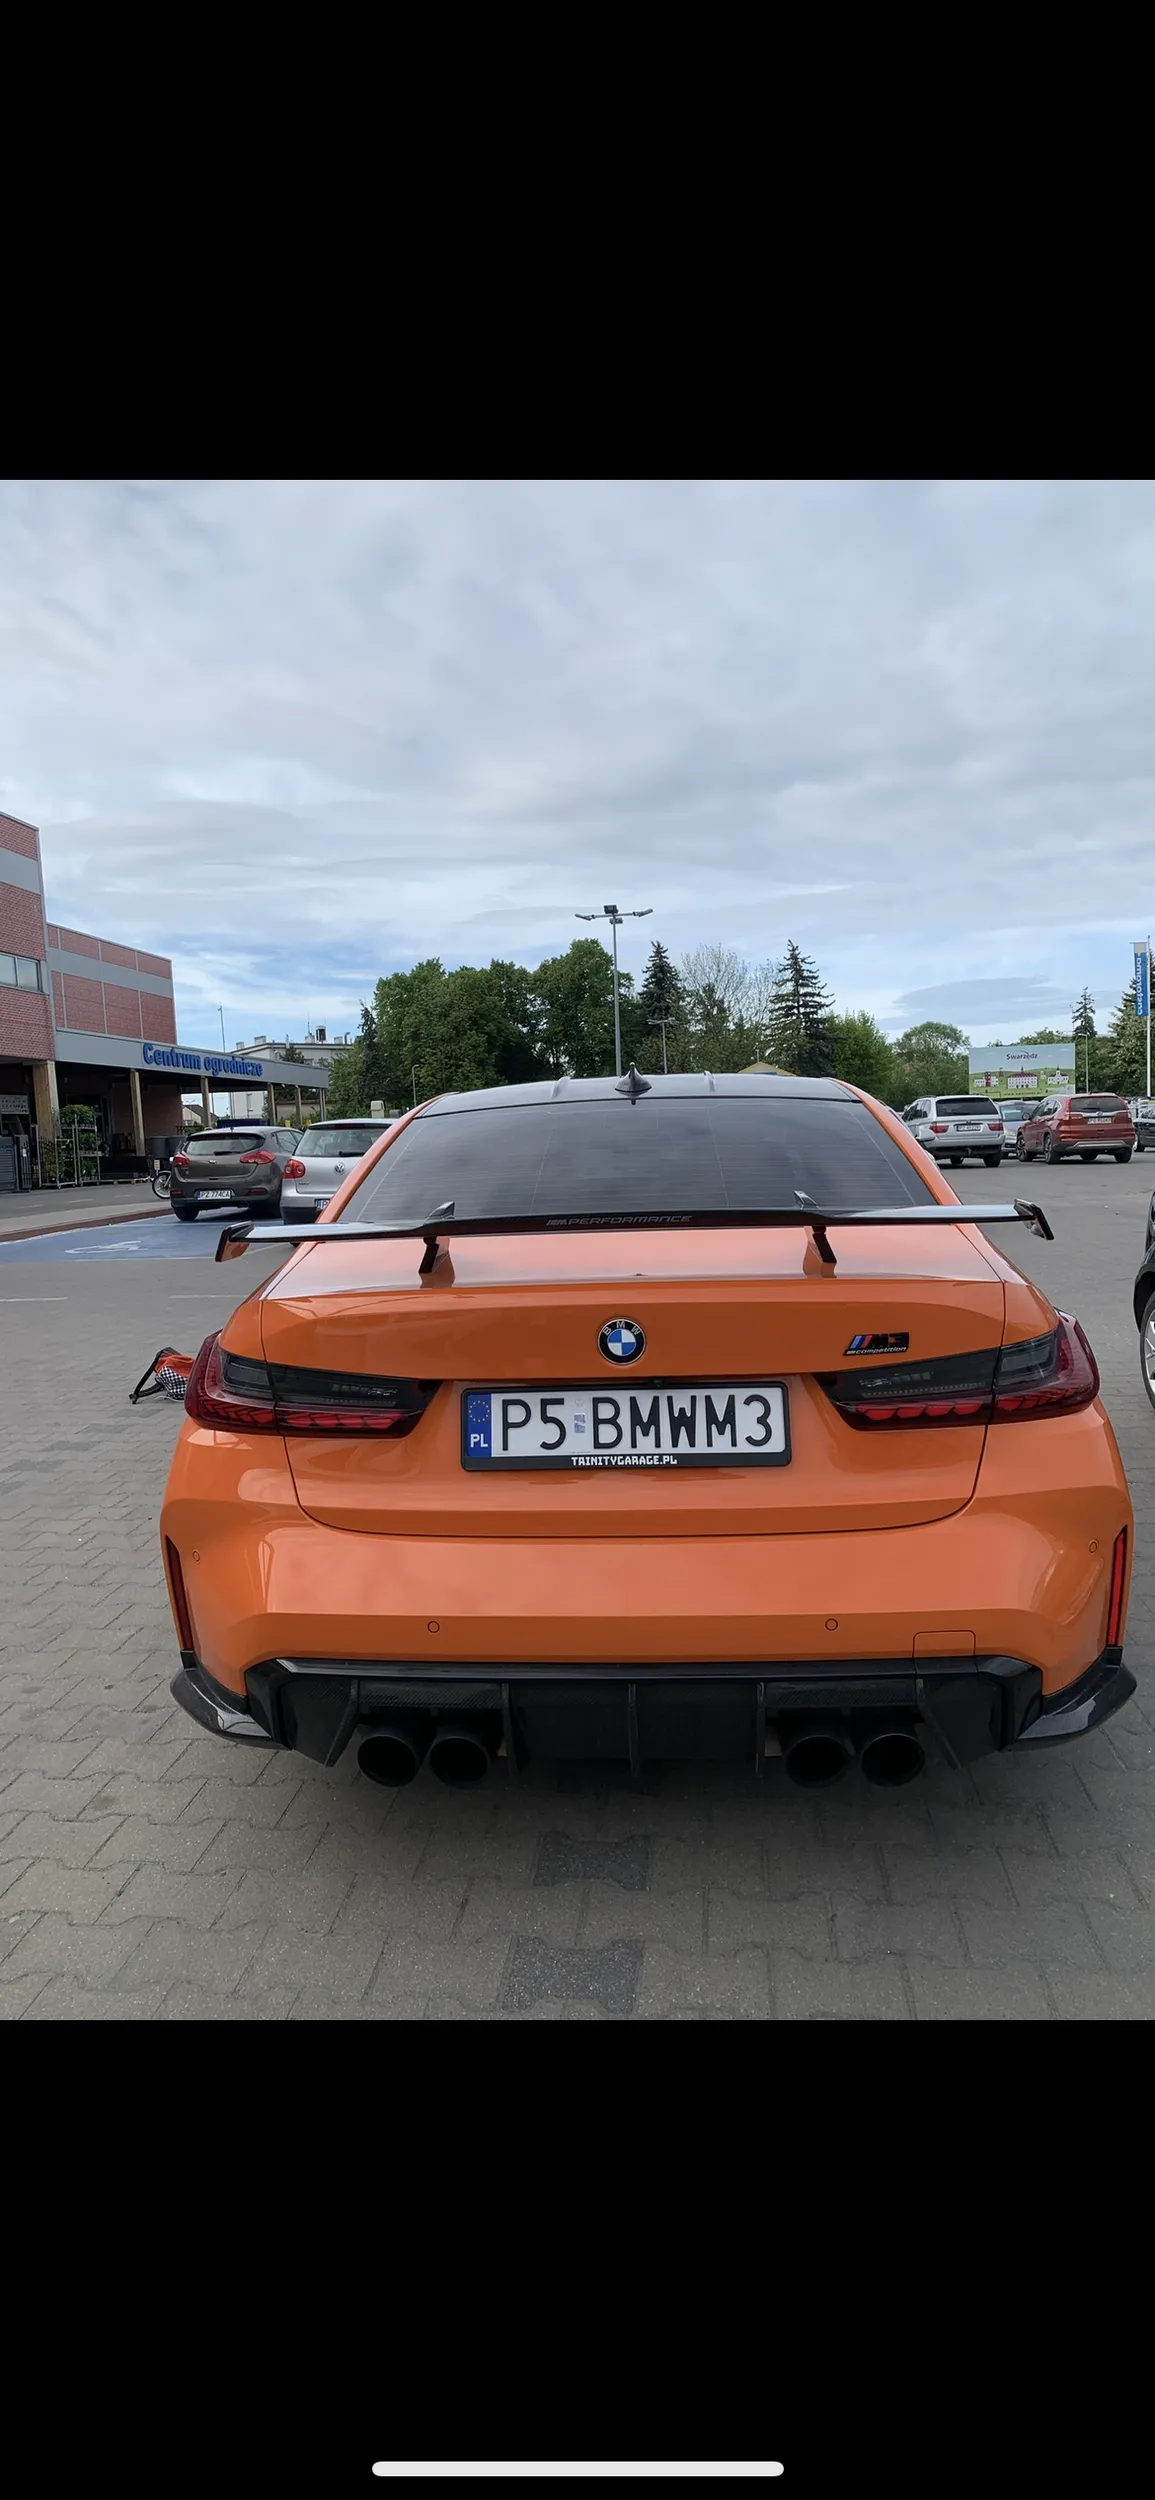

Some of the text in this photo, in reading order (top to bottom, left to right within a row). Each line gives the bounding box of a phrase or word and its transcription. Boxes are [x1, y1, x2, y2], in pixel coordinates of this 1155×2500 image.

[143, 1042, 263, 1077] Centrum ogrodnicze
[1006, 1052, 1038, 1061] Swarzędz
[567, 1215, 693, 1225] PERFORMANCE
[602, 1321, 641, 1336] BMW
[502, 1394, 772, 1451] P5 BMWM3
[470, 1433, 489, 1448] PL
[571, 1455, 678, 1466] TRINITYGARAGE.PL
